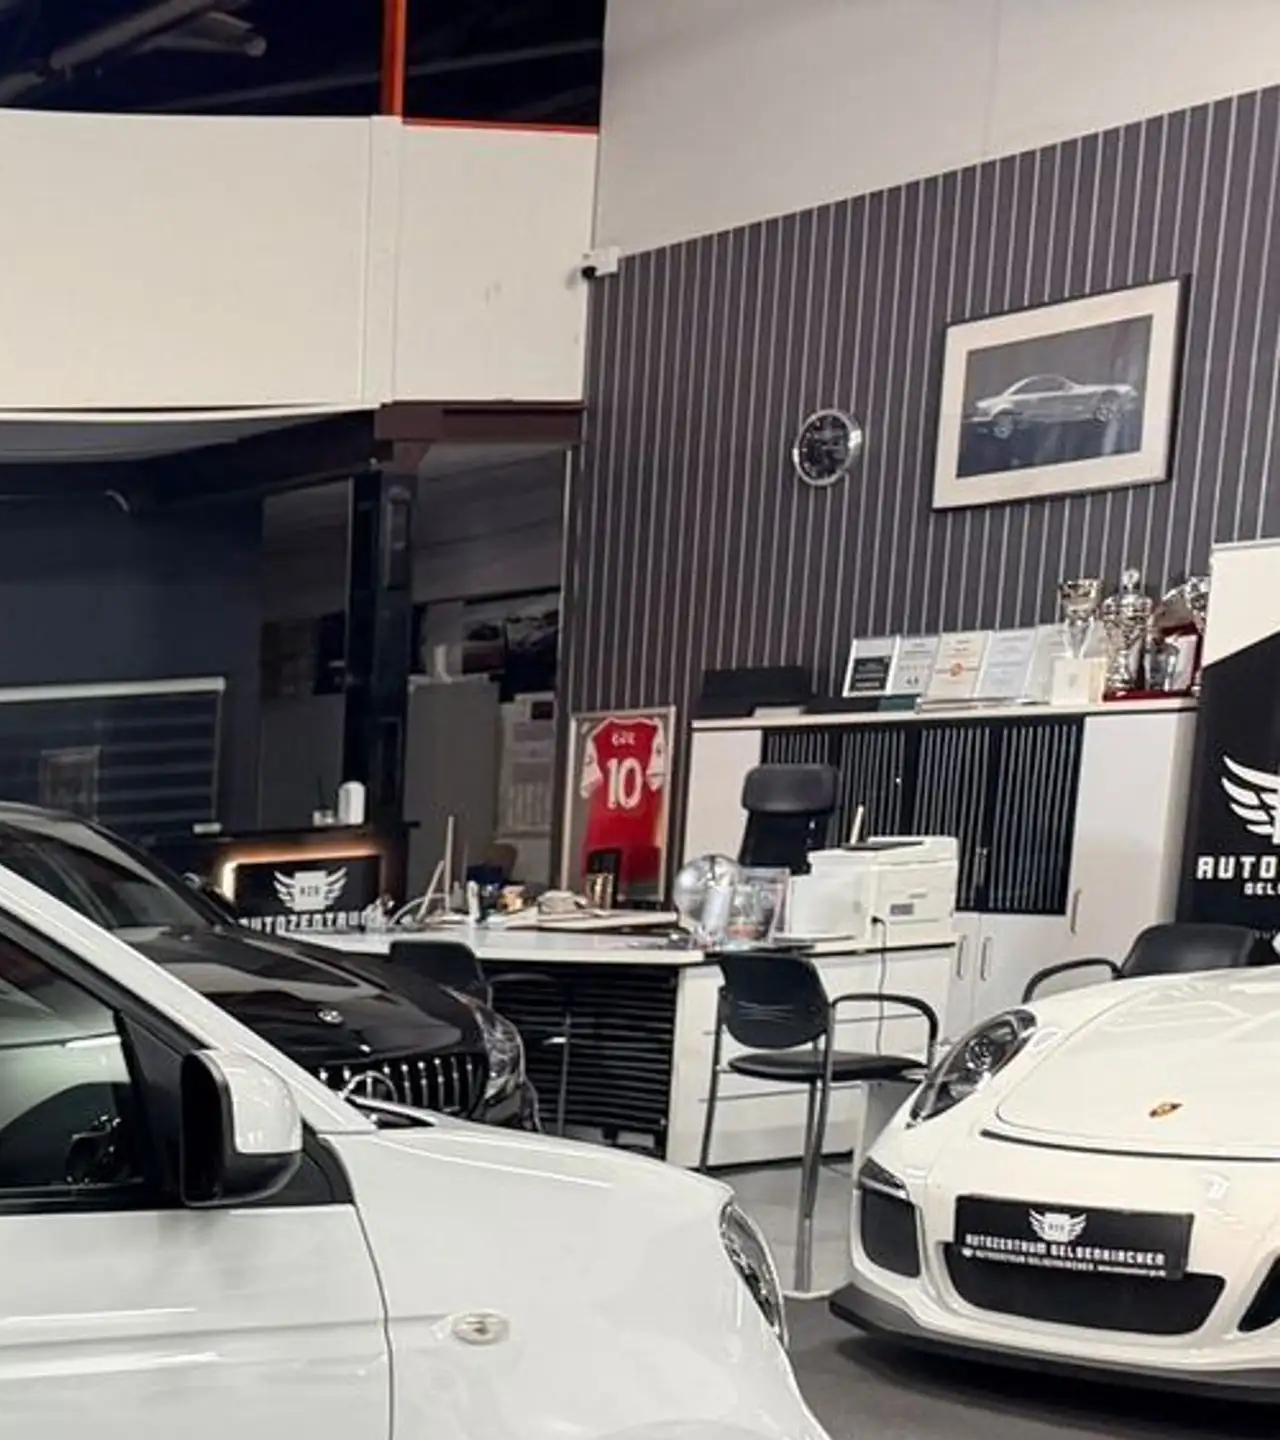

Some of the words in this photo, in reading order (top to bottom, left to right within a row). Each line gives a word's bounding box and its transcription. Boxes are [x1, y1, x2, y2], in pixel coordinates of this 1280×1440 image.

[606, 757, 642, 809] 10
[1196, 855, 1278, 879] AUTO
[1244, 881, 1280, 896] GEL
